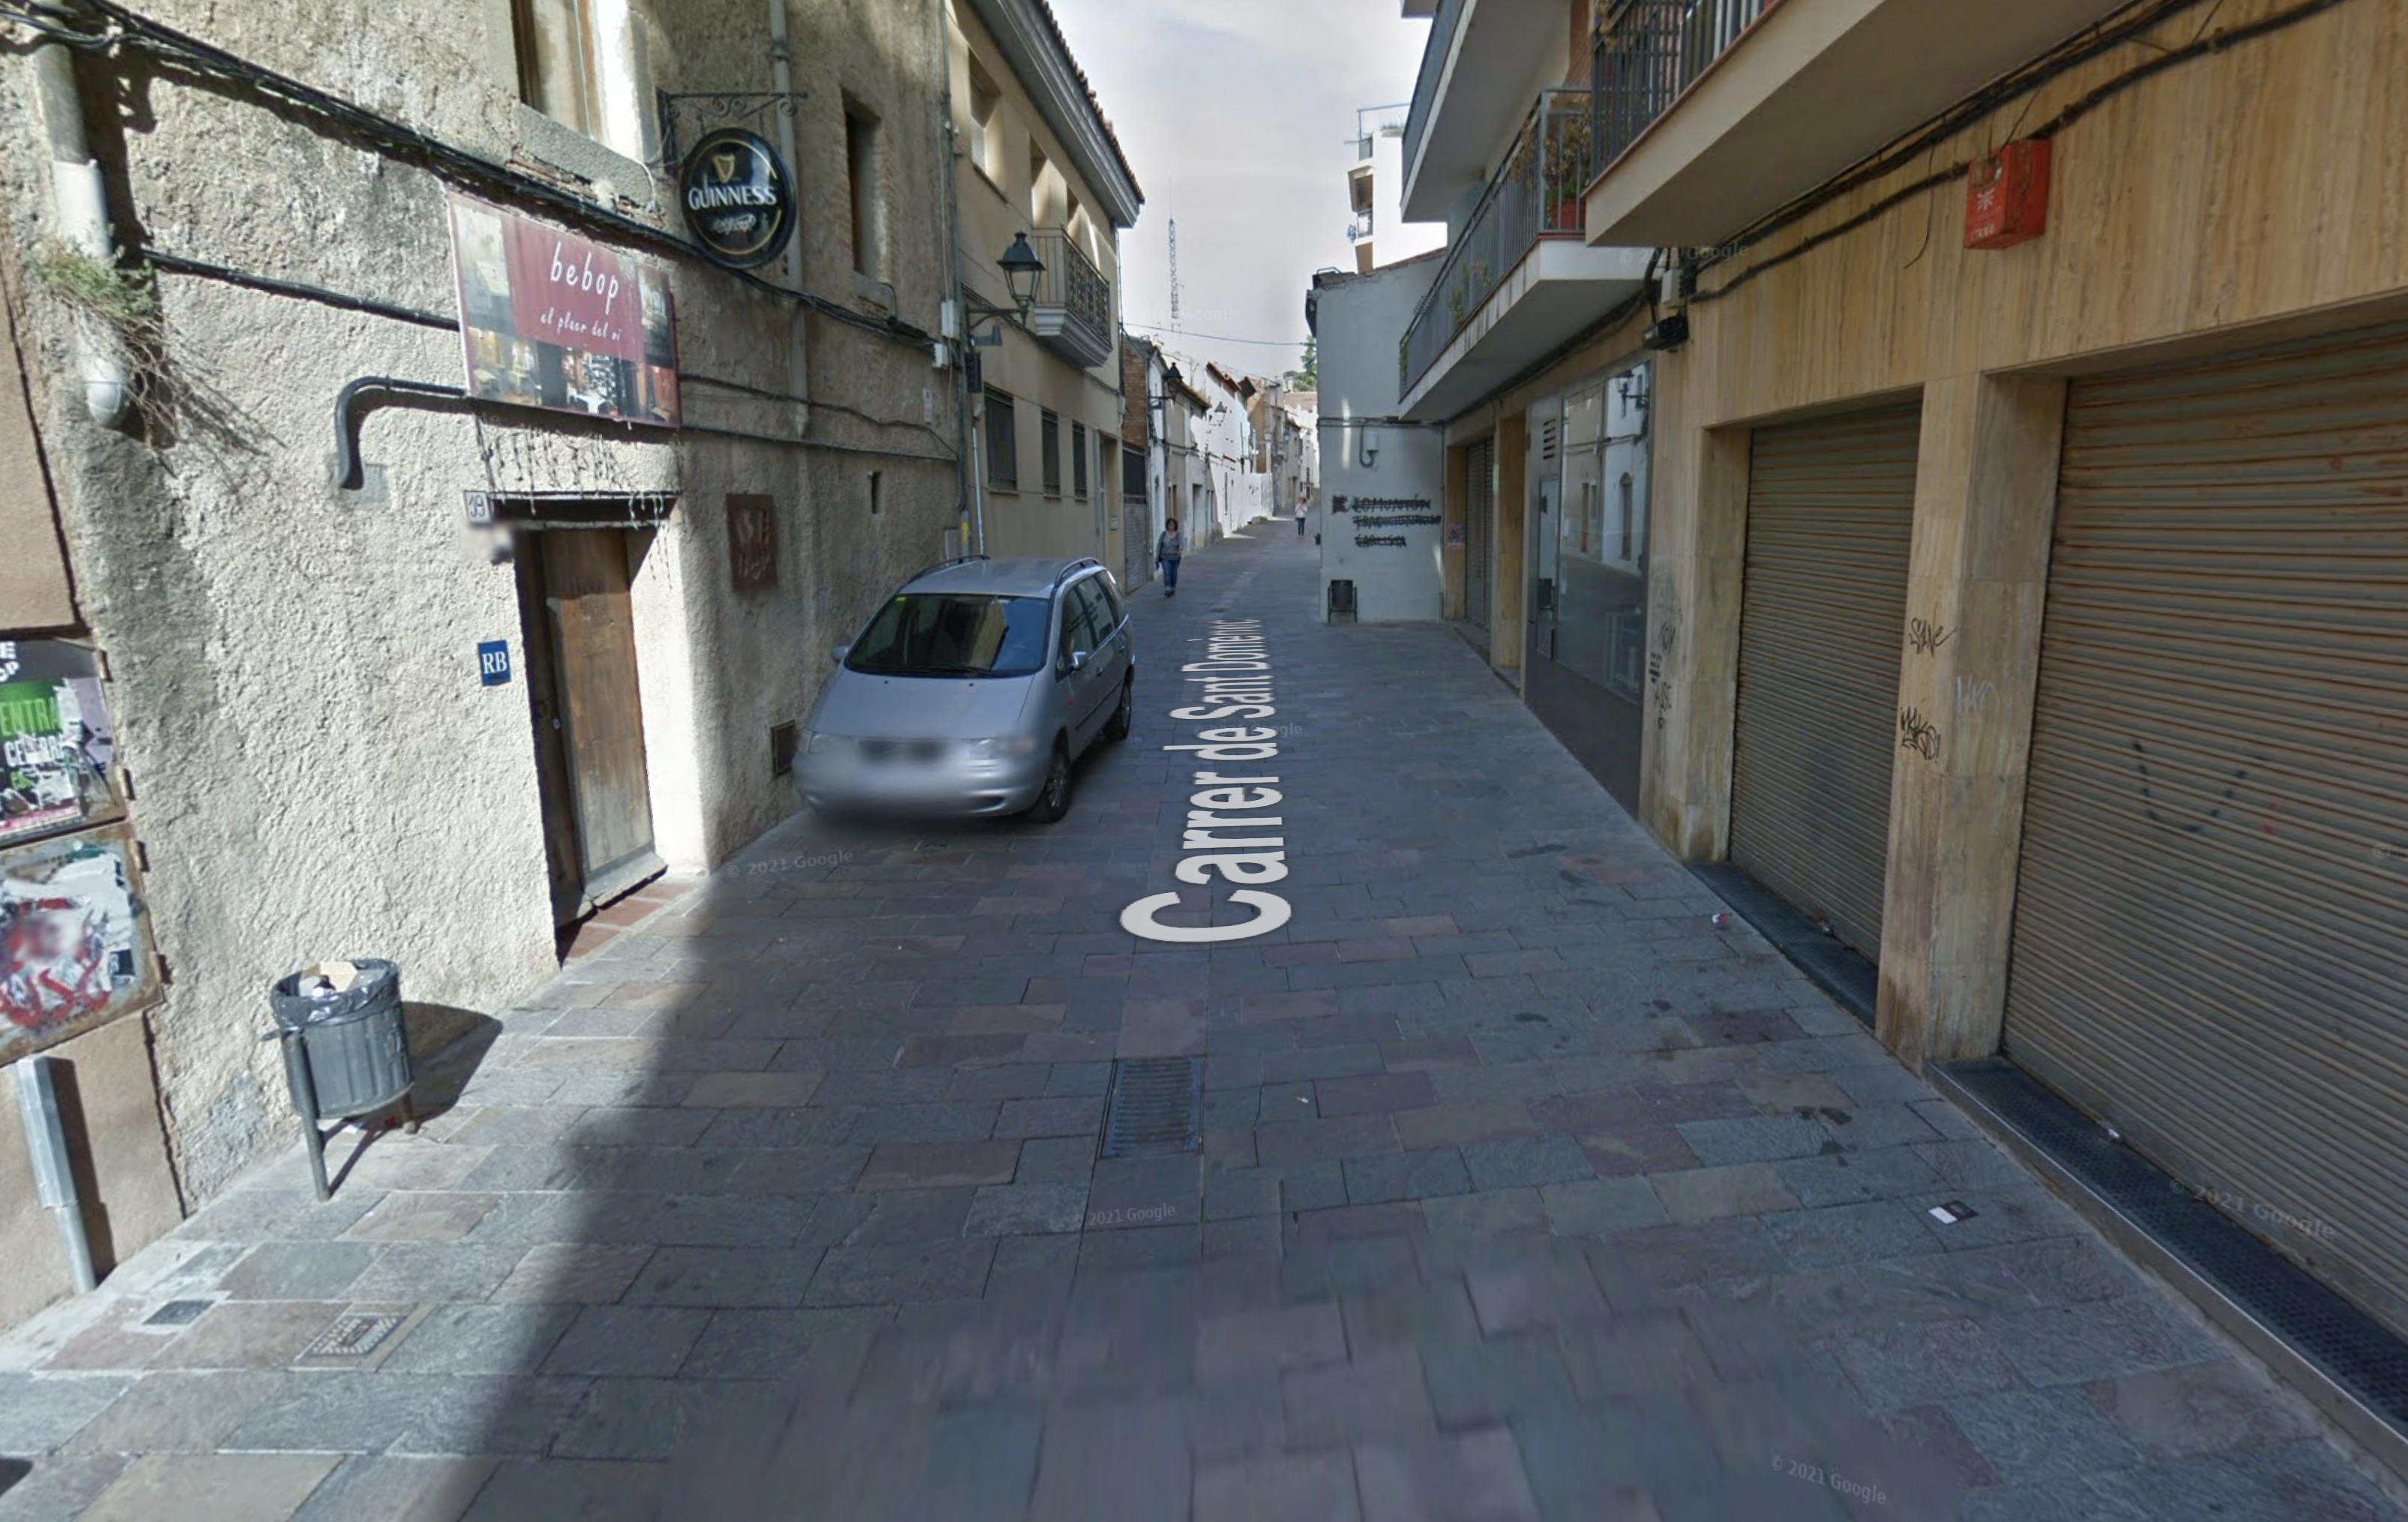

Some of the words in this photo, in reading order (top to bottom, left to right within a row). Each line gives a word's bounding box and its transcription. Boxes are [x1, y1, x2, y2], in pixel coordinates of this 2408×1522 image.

[688, 184, 777, 211] GUINNESS
[550, 241, 619, 316] bebop
[541, 307, 555, 325] el
[591, 319, 609, 338] del
[482, 650, 508, 674] RB
[1180, 619, 1274, 671] Domènec
[1168, 675, 1277, 720] Sant
[1162, 727, 1279, 761] de
[1119, 771, 1292, 942] Carrer
